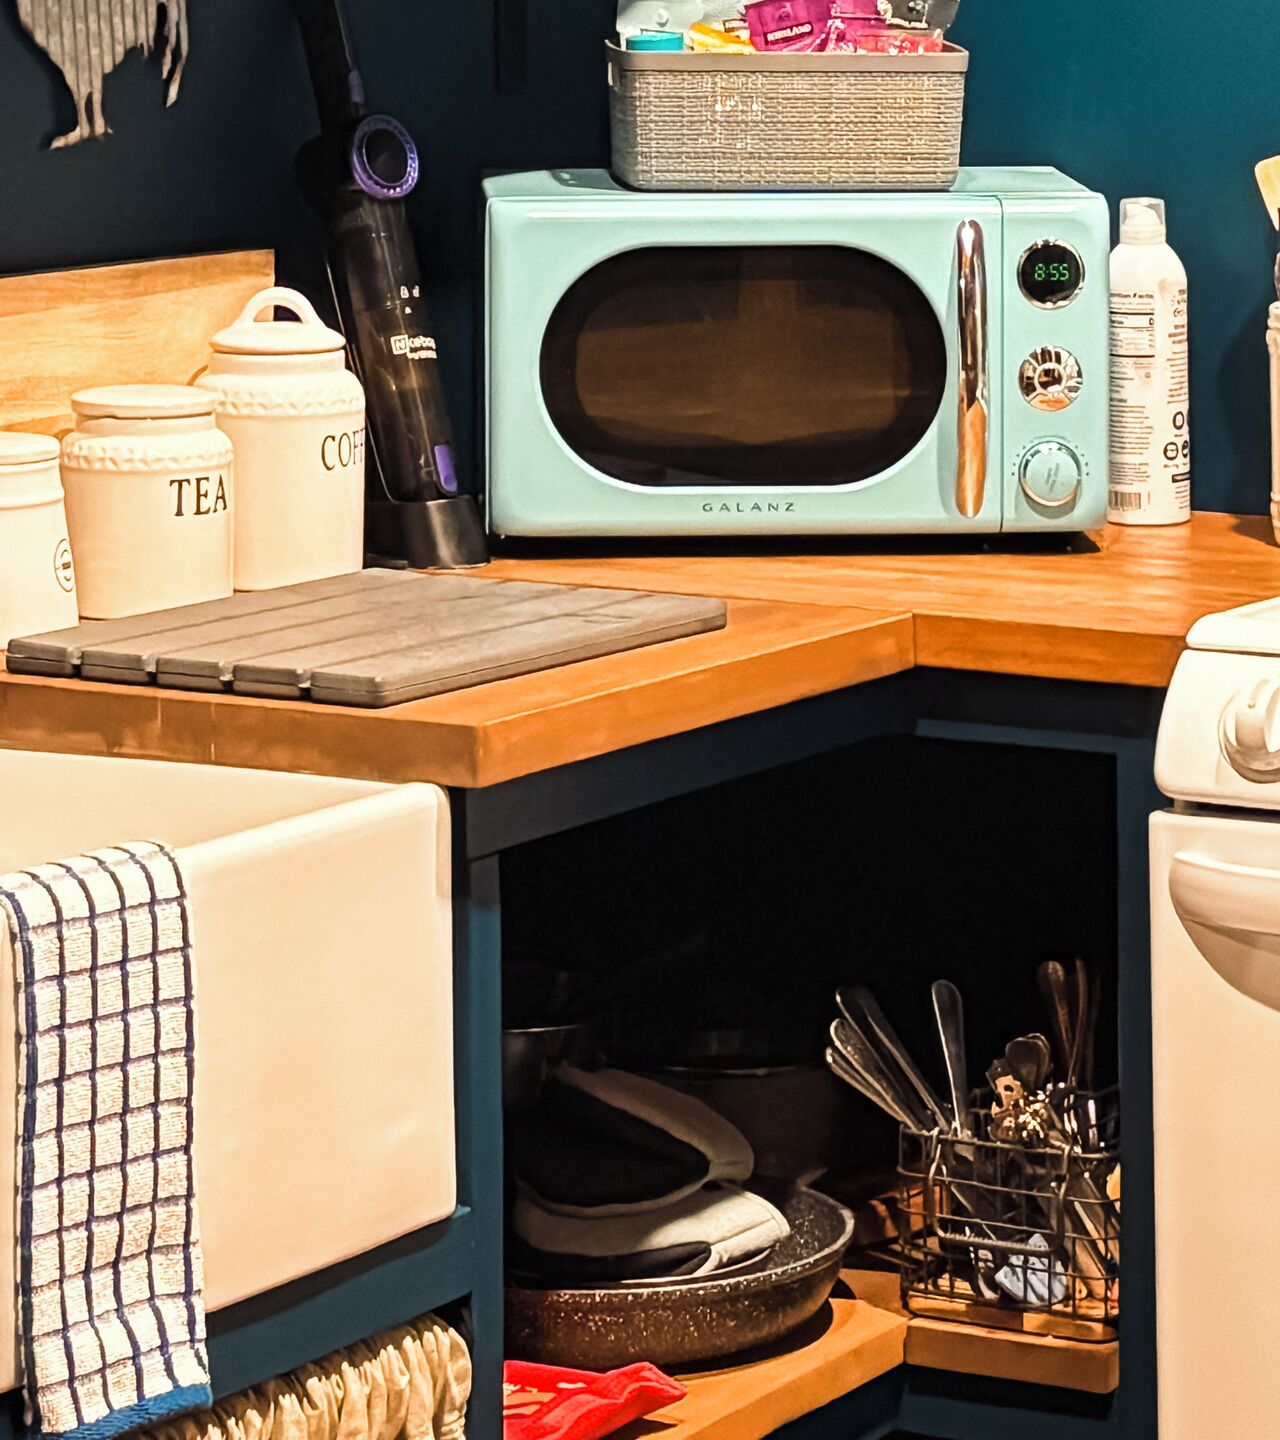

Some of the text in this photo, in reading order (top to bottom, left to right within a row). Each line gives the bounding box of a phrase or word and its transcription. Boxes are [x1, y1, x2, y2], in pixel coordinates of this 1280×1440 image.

[1034, 263, 1069, 280] 8:55
[169, 474, 228, 517] TEA
[702, 502, 795, 513] GALANZ
